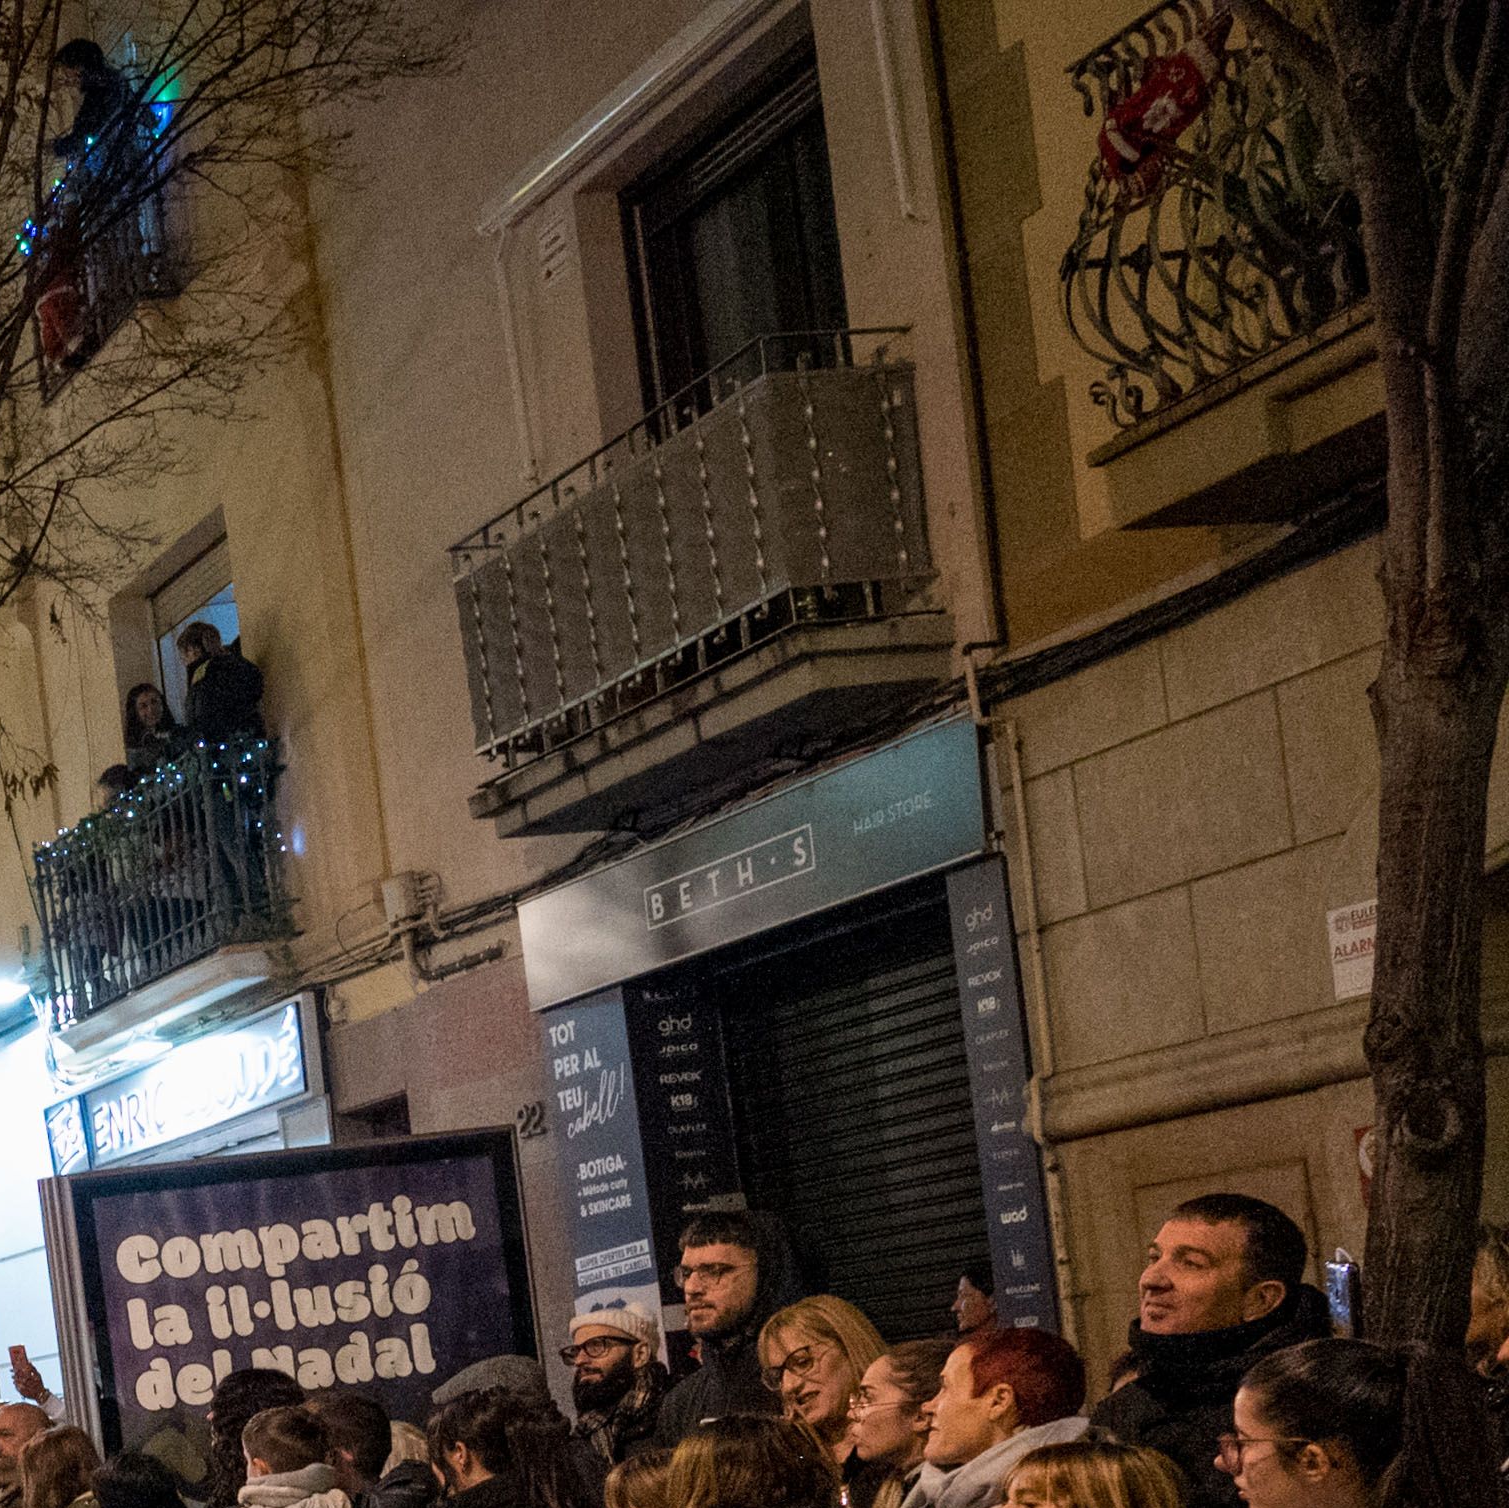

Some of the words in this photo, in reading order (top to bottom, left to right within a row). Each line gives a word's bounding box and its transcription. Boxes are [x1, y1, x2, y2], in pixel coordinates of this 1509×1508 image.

[886, 790, 932, 824] STORE
[1350, 904, 1377, 921] EULE
[1333, 937, 1376, 959] ALARM
[548, 1020, 576, 1048] TOT
[657, 1013, 692, 1037] ghd
[553, 1053, 580, 1081] PER
[583, 1046, 602, 1071] AL
[557, 1085, 583, 1112] TEU
[567, 1062, 625, 1139] cabell!
[91, 1080, 167, 1156] ENRIC
[517, 1100, 548, 1139] 22
[588, 1193, 632, 1216] SKINCARE
[116, 1194, 476, 1284] Compartim
[126, 1298, 193, 1350] la
[205, 1258, 431, 1340] il·lusió
[135, 1349, 233, 1411] del
[251, 1322, 436, 1390] Nadal
